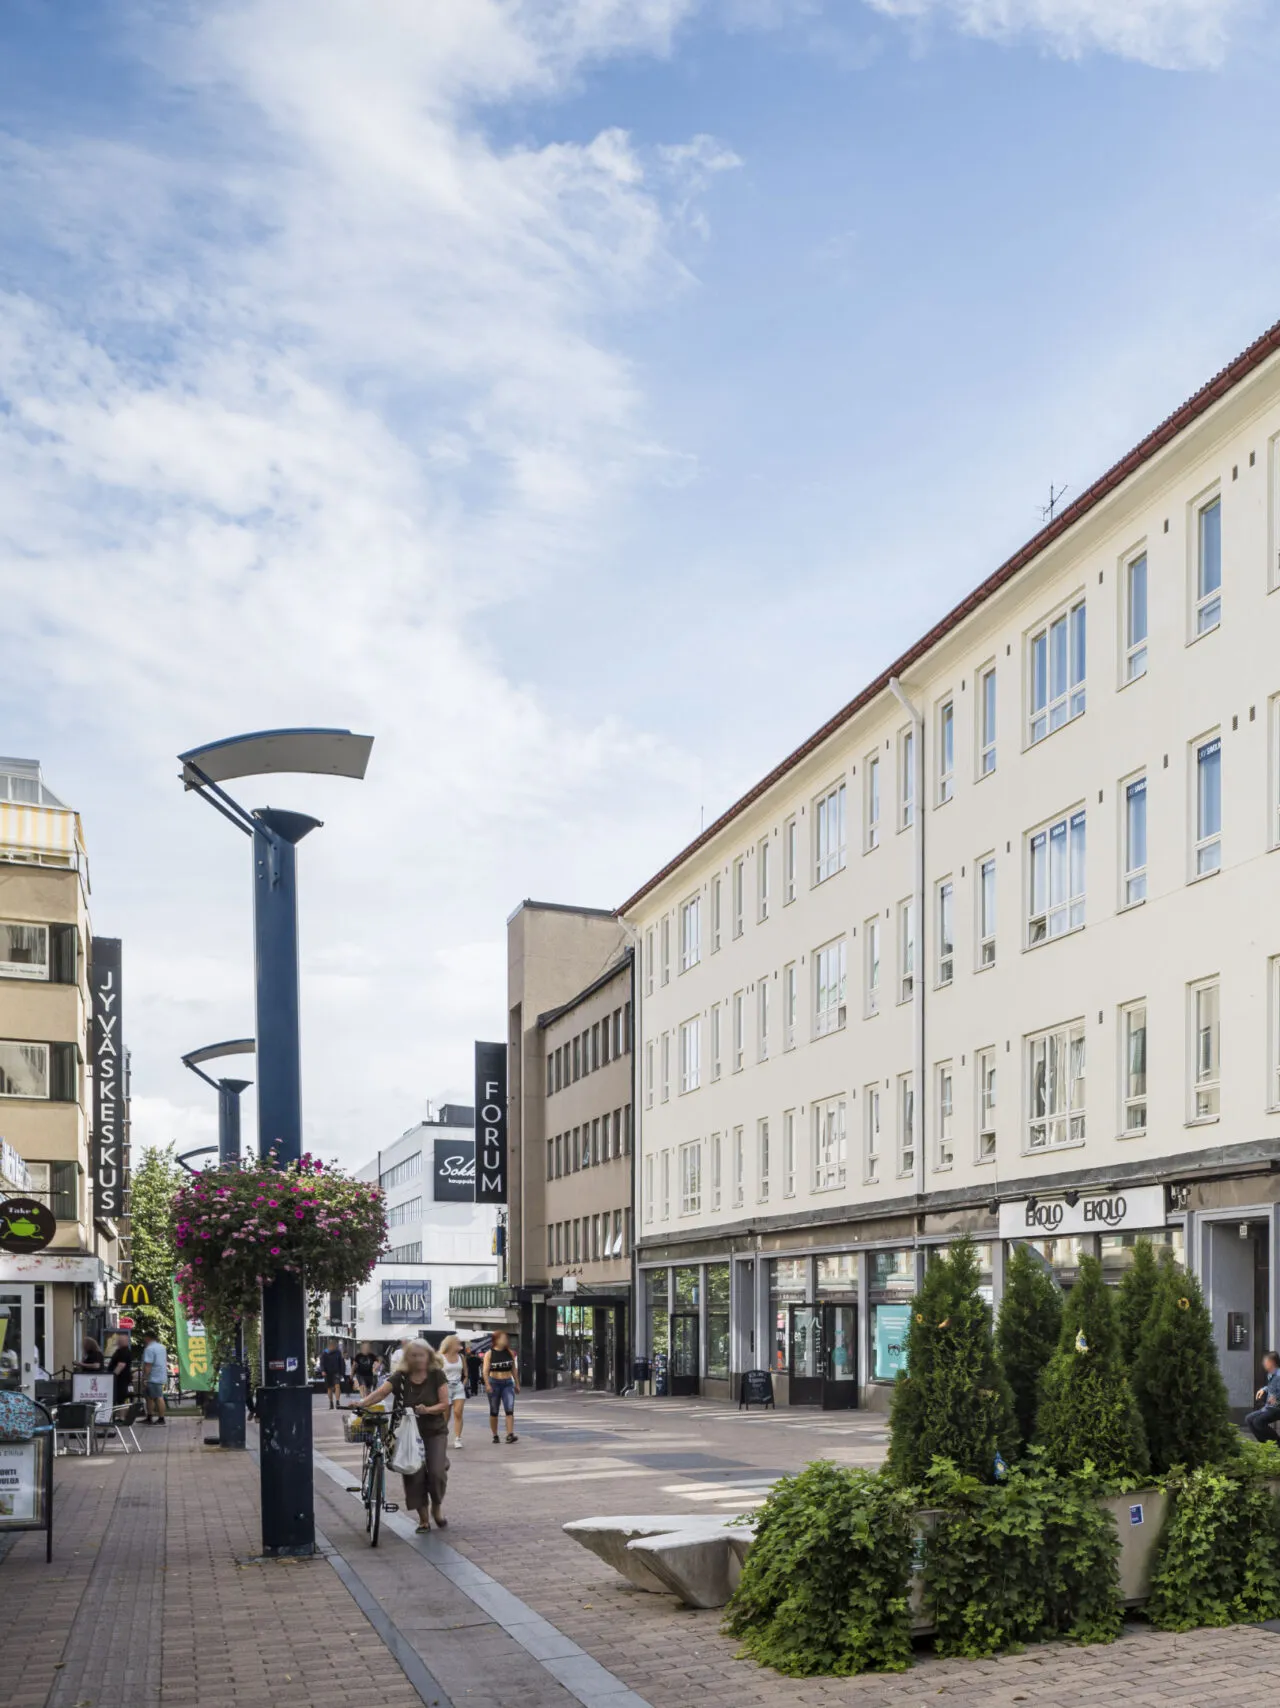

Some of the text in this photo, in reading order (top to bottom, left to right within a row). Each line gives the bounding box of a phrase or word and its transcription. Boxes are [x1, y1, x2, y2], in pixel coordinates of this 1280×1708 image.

[97, 971, 117, 1210] JYVÄSKESKUS
[481, 1081, 502, 1193] FORUM
[1025, 1203, 1063, 1227] EKOLO
[1083, 1196, 1127, 1222] EKOLO
[388, 1293, 426, 1311] SOKOS
